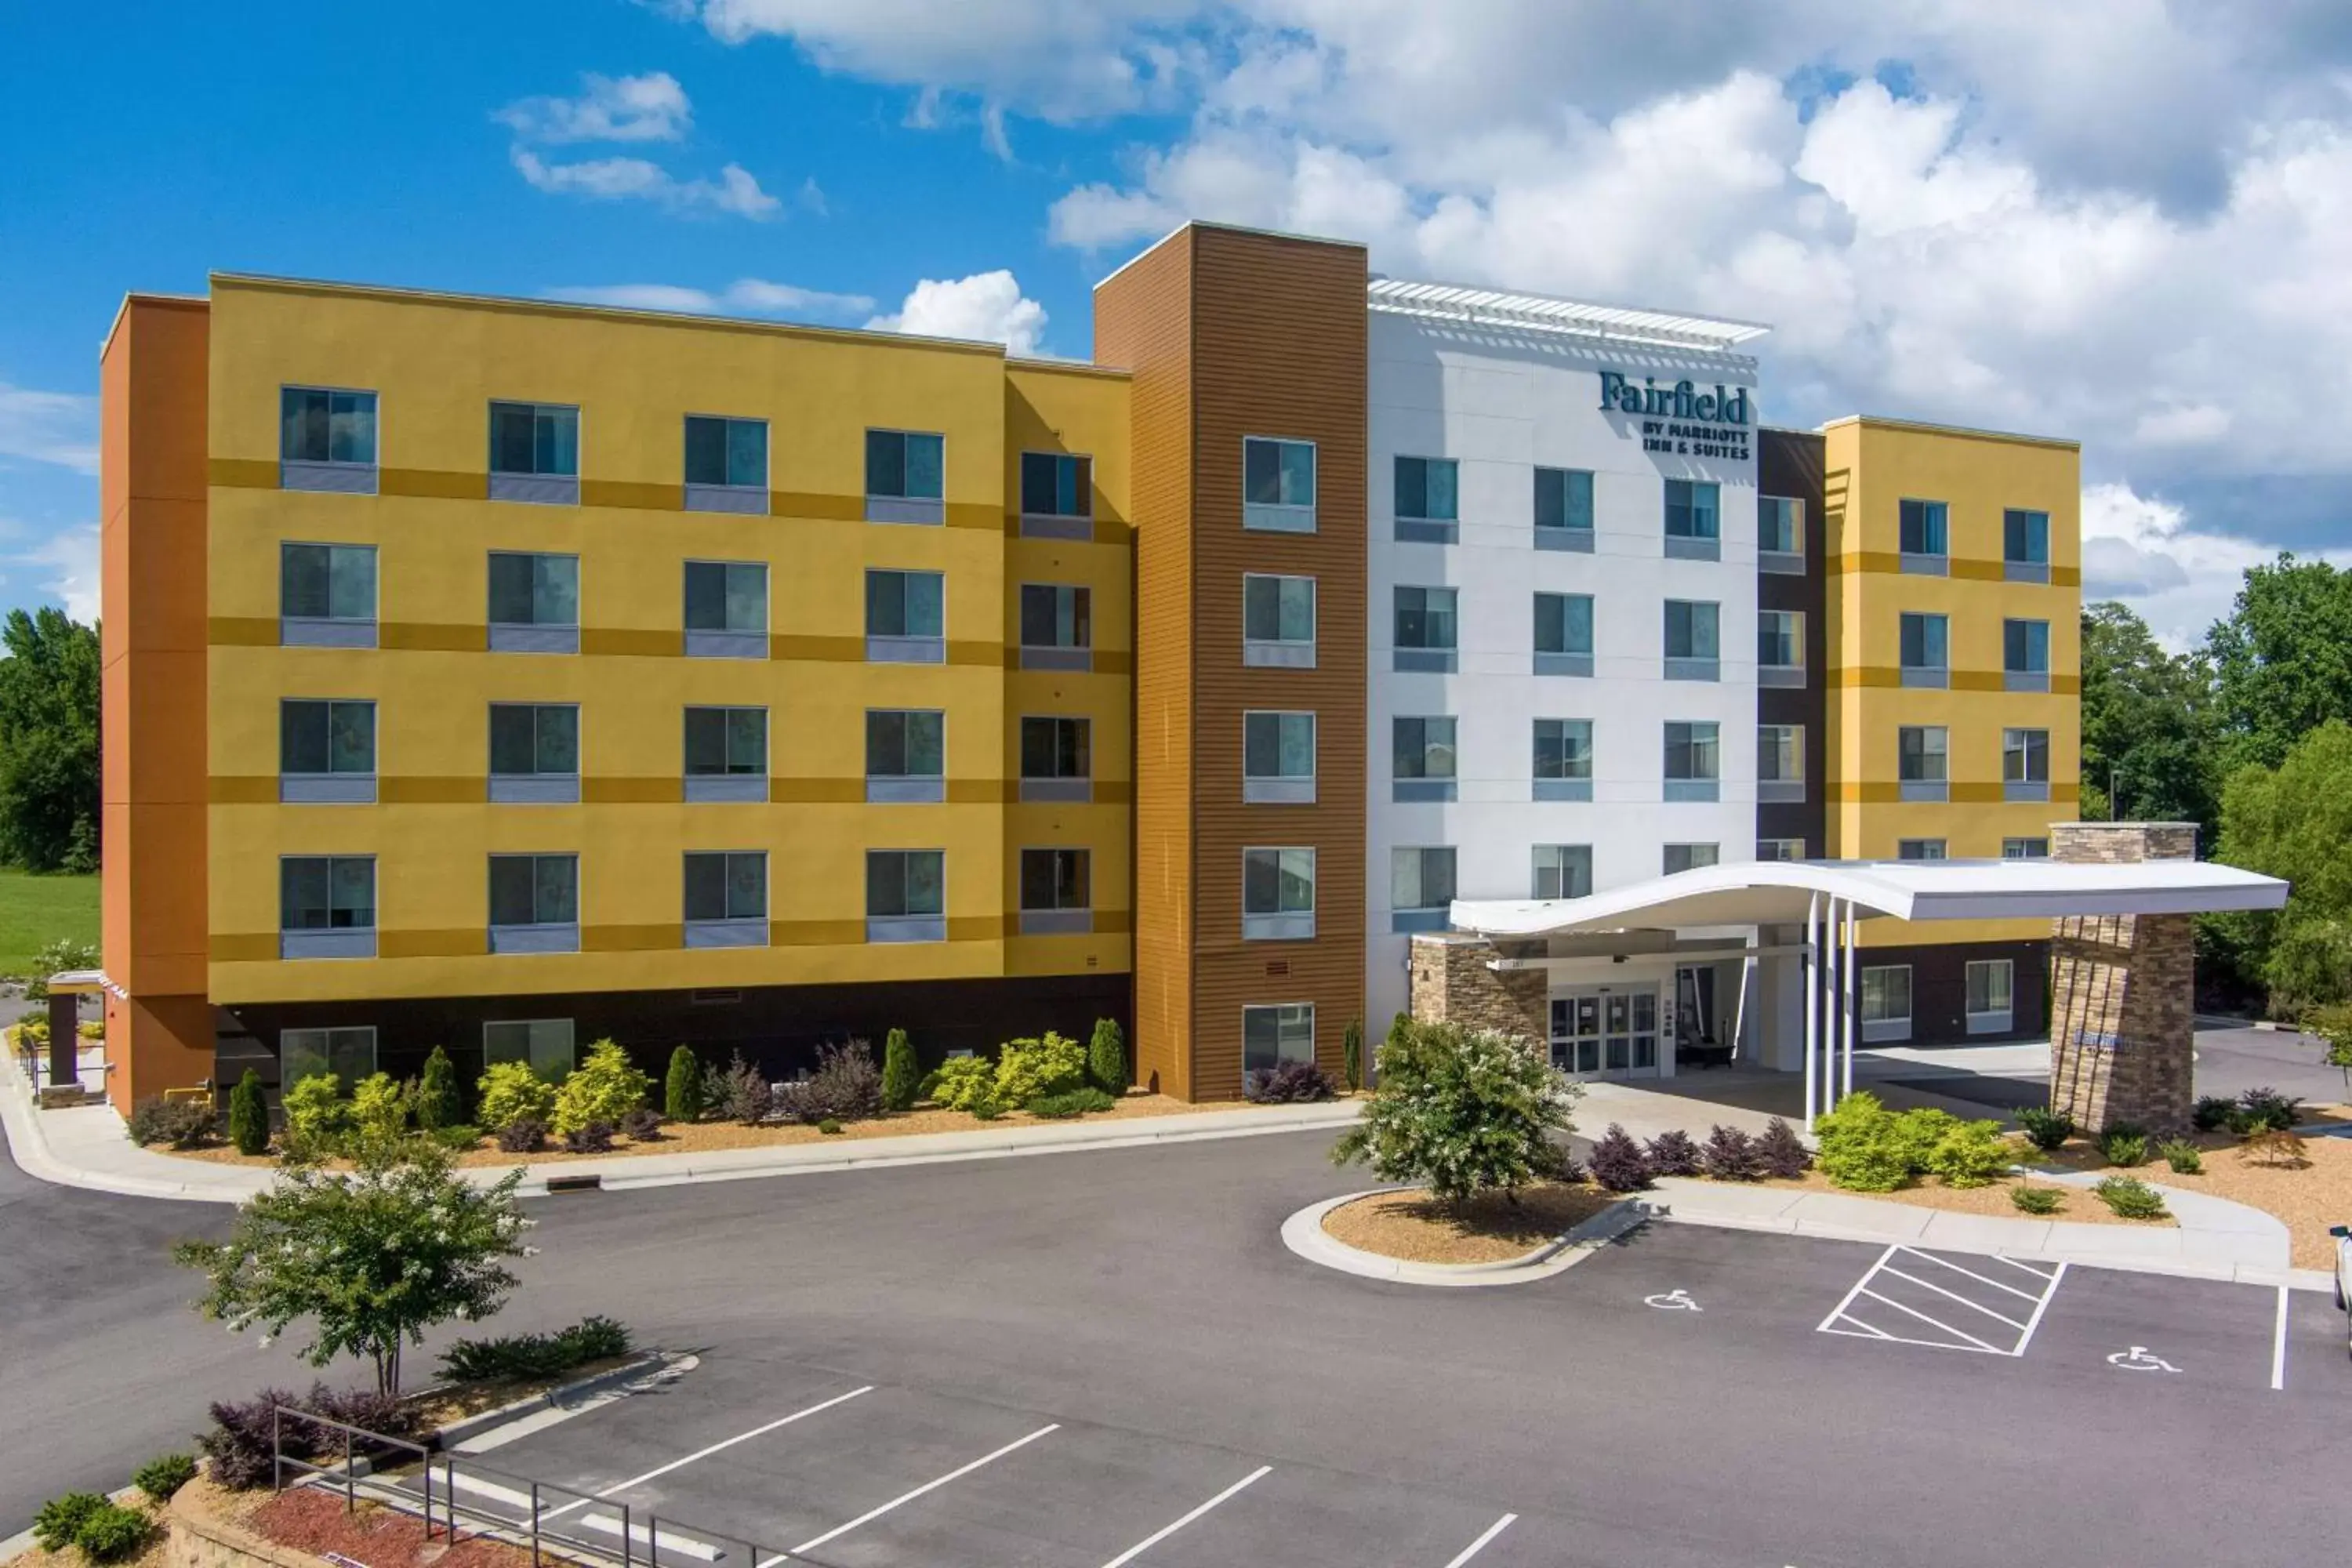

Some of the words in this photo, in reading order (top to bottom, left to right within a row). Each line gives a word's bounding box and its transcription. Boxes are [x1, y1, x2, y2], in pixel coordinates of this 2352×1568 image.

[1598, 371, 1749, 425] Fairfield
[1643, 421, 1664, 435] BY
[1668, 424, 1749, 444] MARRIOTT
[1643, 438, 1672, 452] INN
[1679, 441, 1688, 454] &
[1693, 443, 1749, 460] SUITES
